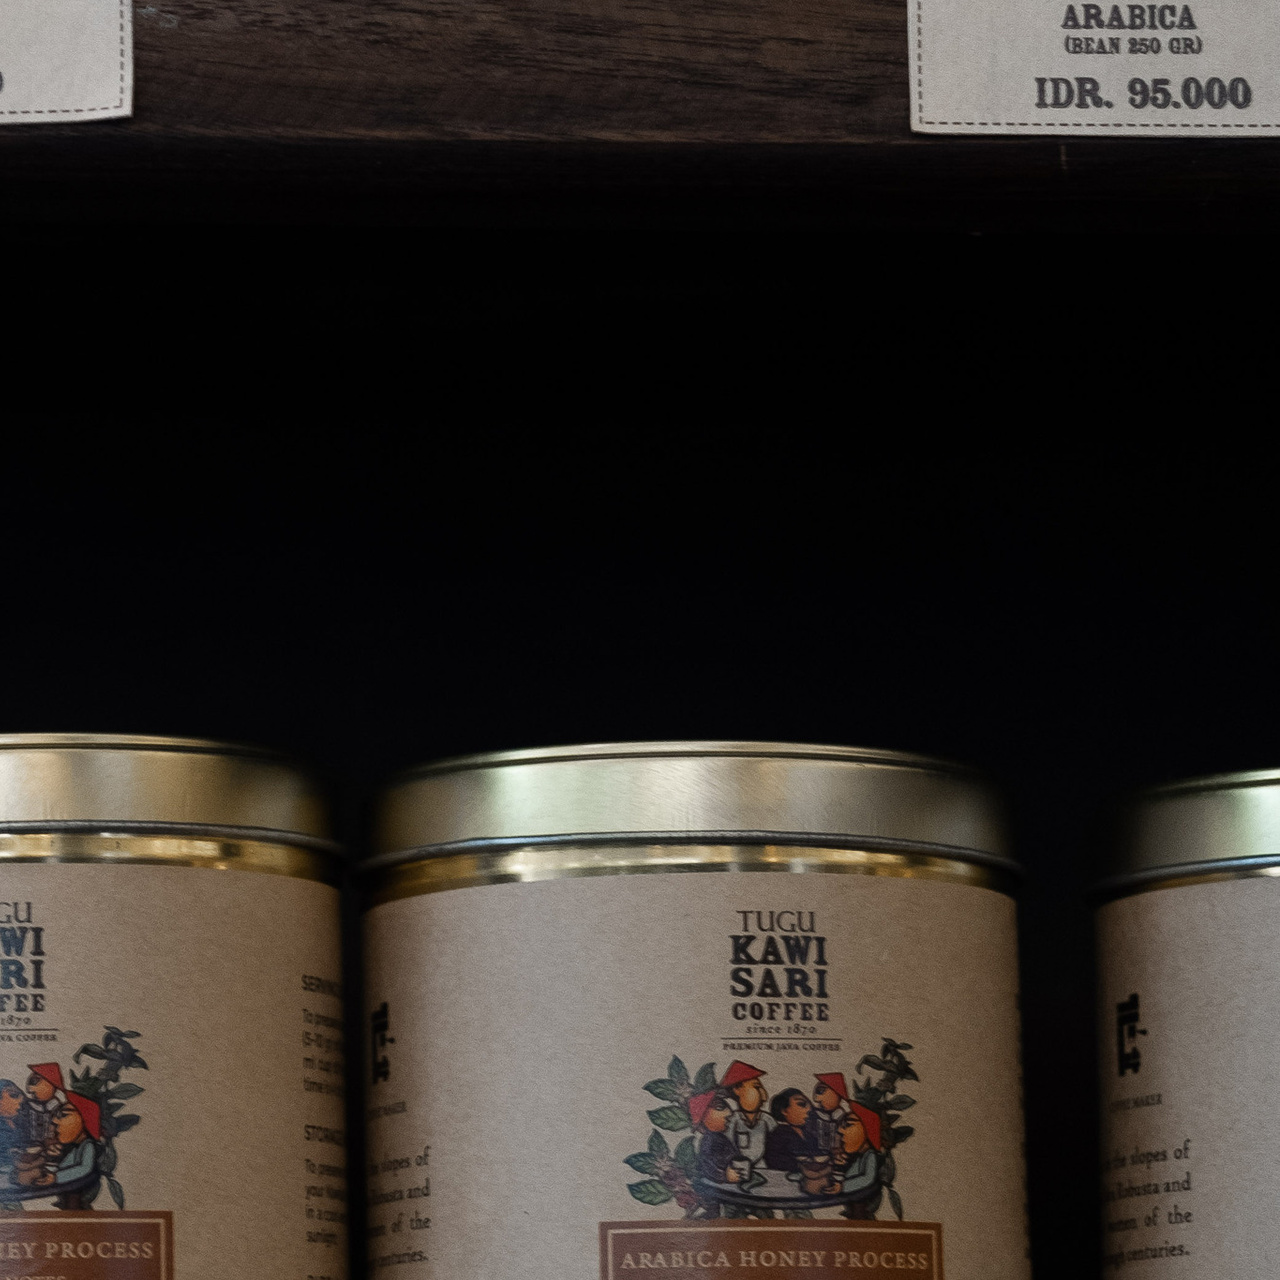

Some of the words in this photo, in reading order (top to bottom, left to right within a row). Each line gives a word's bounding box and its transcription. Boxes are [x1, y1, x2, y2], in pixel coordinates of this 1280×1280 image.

[1061, 4, 1197, 30] ARABICA
[1064, 35, 1120, 55] (BEAN
[1128, 37, 1161, 55] 250
[1168, 35, 1202, 55] GR)
[1035, 77, 1114, 109] IDR.
[1128, 77, 1252, 109] 95.000
[736, 910, 815, 932] TUGU
[729, 935, 828, 965] KAWI
[730, 967, 828, 998] SARI
[732, 1002, 829, 1021] COFFEE
[45, 1241, 154, 1260] PROCESS
[620, 1252, 731, 1270] ARABICA
[739, 1250, 827, 1269] HONEY
[835, 1251, 928, 1270] PROCESS
